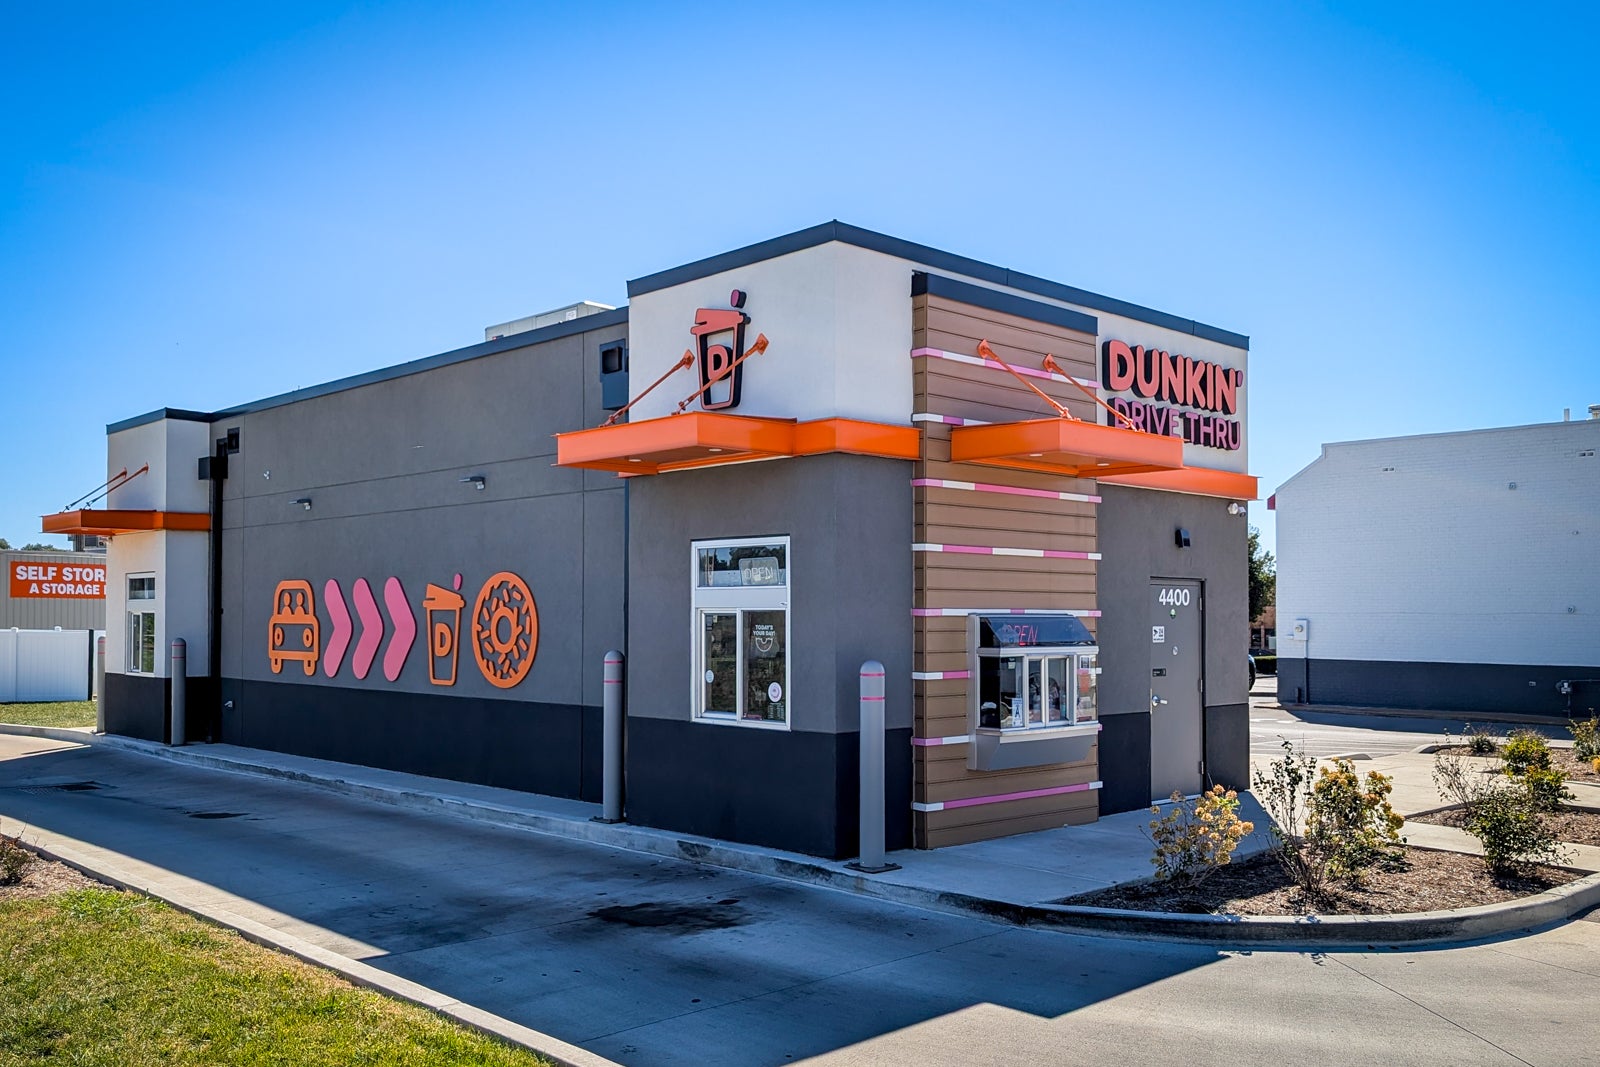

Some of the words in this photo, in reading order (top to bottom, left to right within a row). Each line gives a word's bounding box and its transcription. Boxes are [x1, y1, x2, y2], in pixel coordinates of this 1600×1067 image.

[707, 344, 731, 380] D
[1103, 340, 1243, 415] DUNKIN'
[1109, 397, 1181, 438] DRIVE
[1183, 412, 1241, 450] THRU
[16, 565, 57, 581] SELF
[62, 567, 106, 582] STOR
[744, 567, 773, 579] OPEN
[29, 583, 39, 594] A
[42, 583, 100, 595] STORAGE
[1159, 588, 1190, 606] 4400
[435, 622, 452, 657] D
